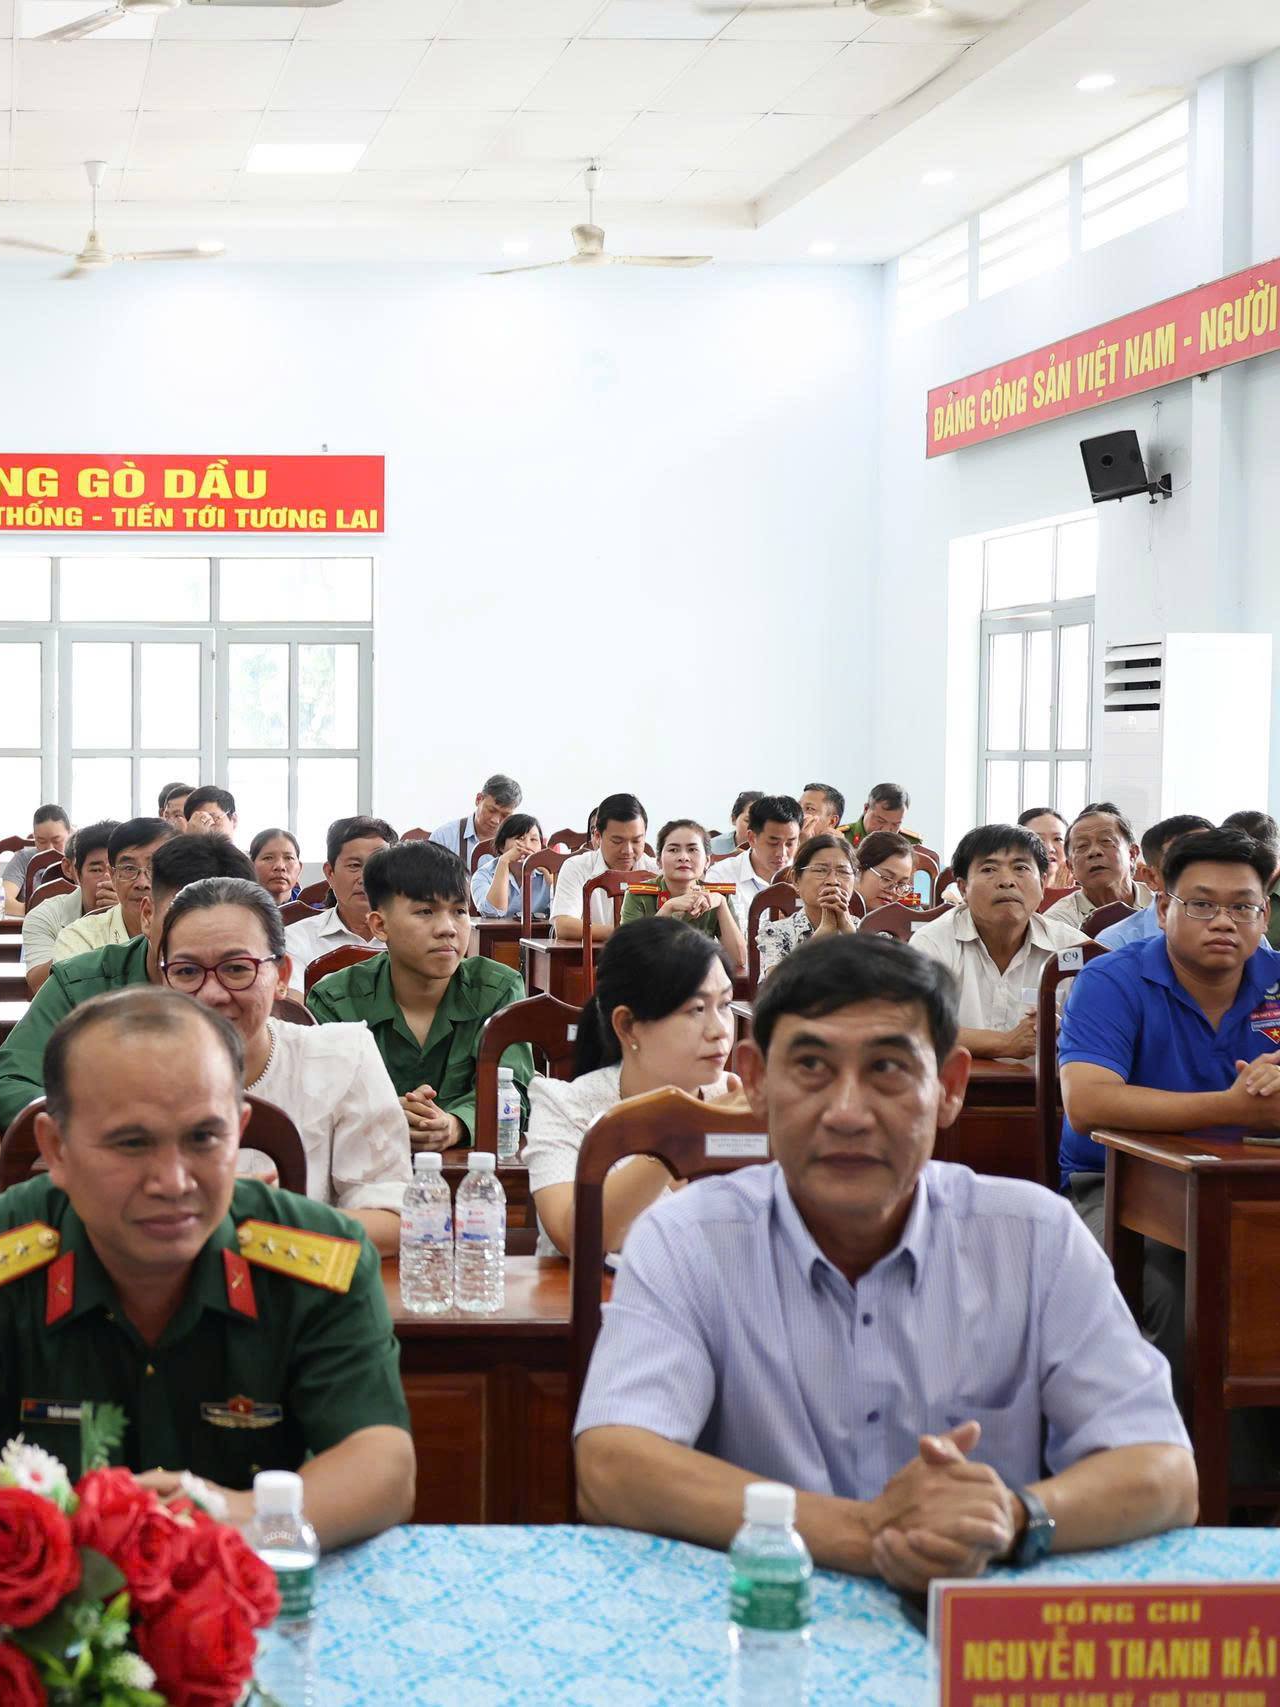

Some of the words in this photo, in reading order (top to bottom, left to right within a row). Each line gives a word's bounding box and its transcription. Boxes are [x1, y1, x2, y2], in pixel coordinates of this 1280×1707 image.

[934, 393, 976, 442] ĐẢNG
[981, 377, 1028, 430] CỘNG
[1033, 353, 1072, 408] SẢN
[1078, 340, 1120, 397] VIỆT
[1125, 323, 1176, 379] NAM
[1200, 279, 1278, 355] NGƯỜI
[78, 460, 146, 499] GÒ
[163, 459, 268, 500] DẦU
[111, 502, 174, 528] TIẾN
[183, 503, 226, 528] TỚI
[234, 506, 327, 529] TƯƠNG
[336, 509, 379, 529] LAI
[1062, 951, 1079, 963] C9
[964, 1626, 1096, 1681] NGUYỄN
[1108, 1638, 1211, 1679] THANH
[1221, 1626, 1278, 1679] HẢI
